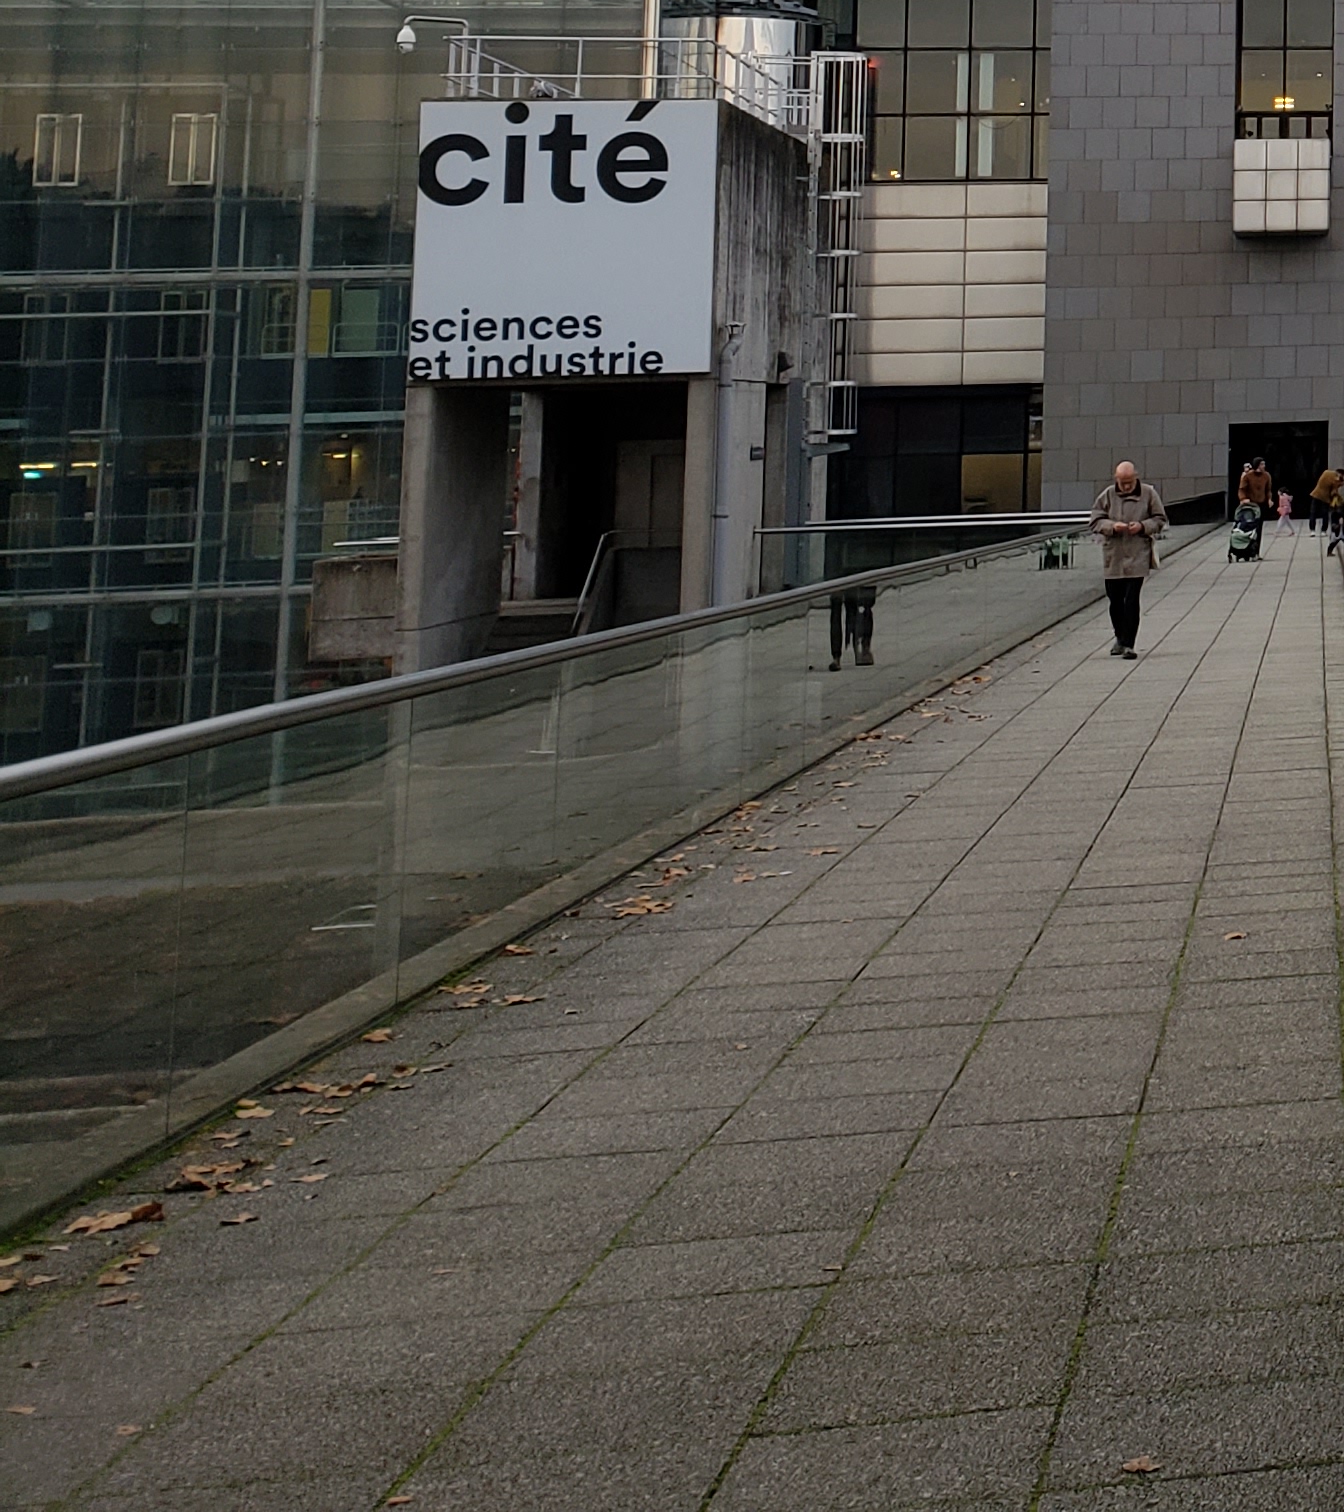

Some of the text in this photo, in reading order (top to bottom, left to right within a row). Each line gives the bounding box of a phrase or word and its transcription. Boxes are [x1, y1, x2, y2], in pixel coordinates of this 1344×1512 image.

[418, 101, 669, 207] cité
[410, 307, 603, 343] sciences
[409, 341, 664, 380] et industrie
